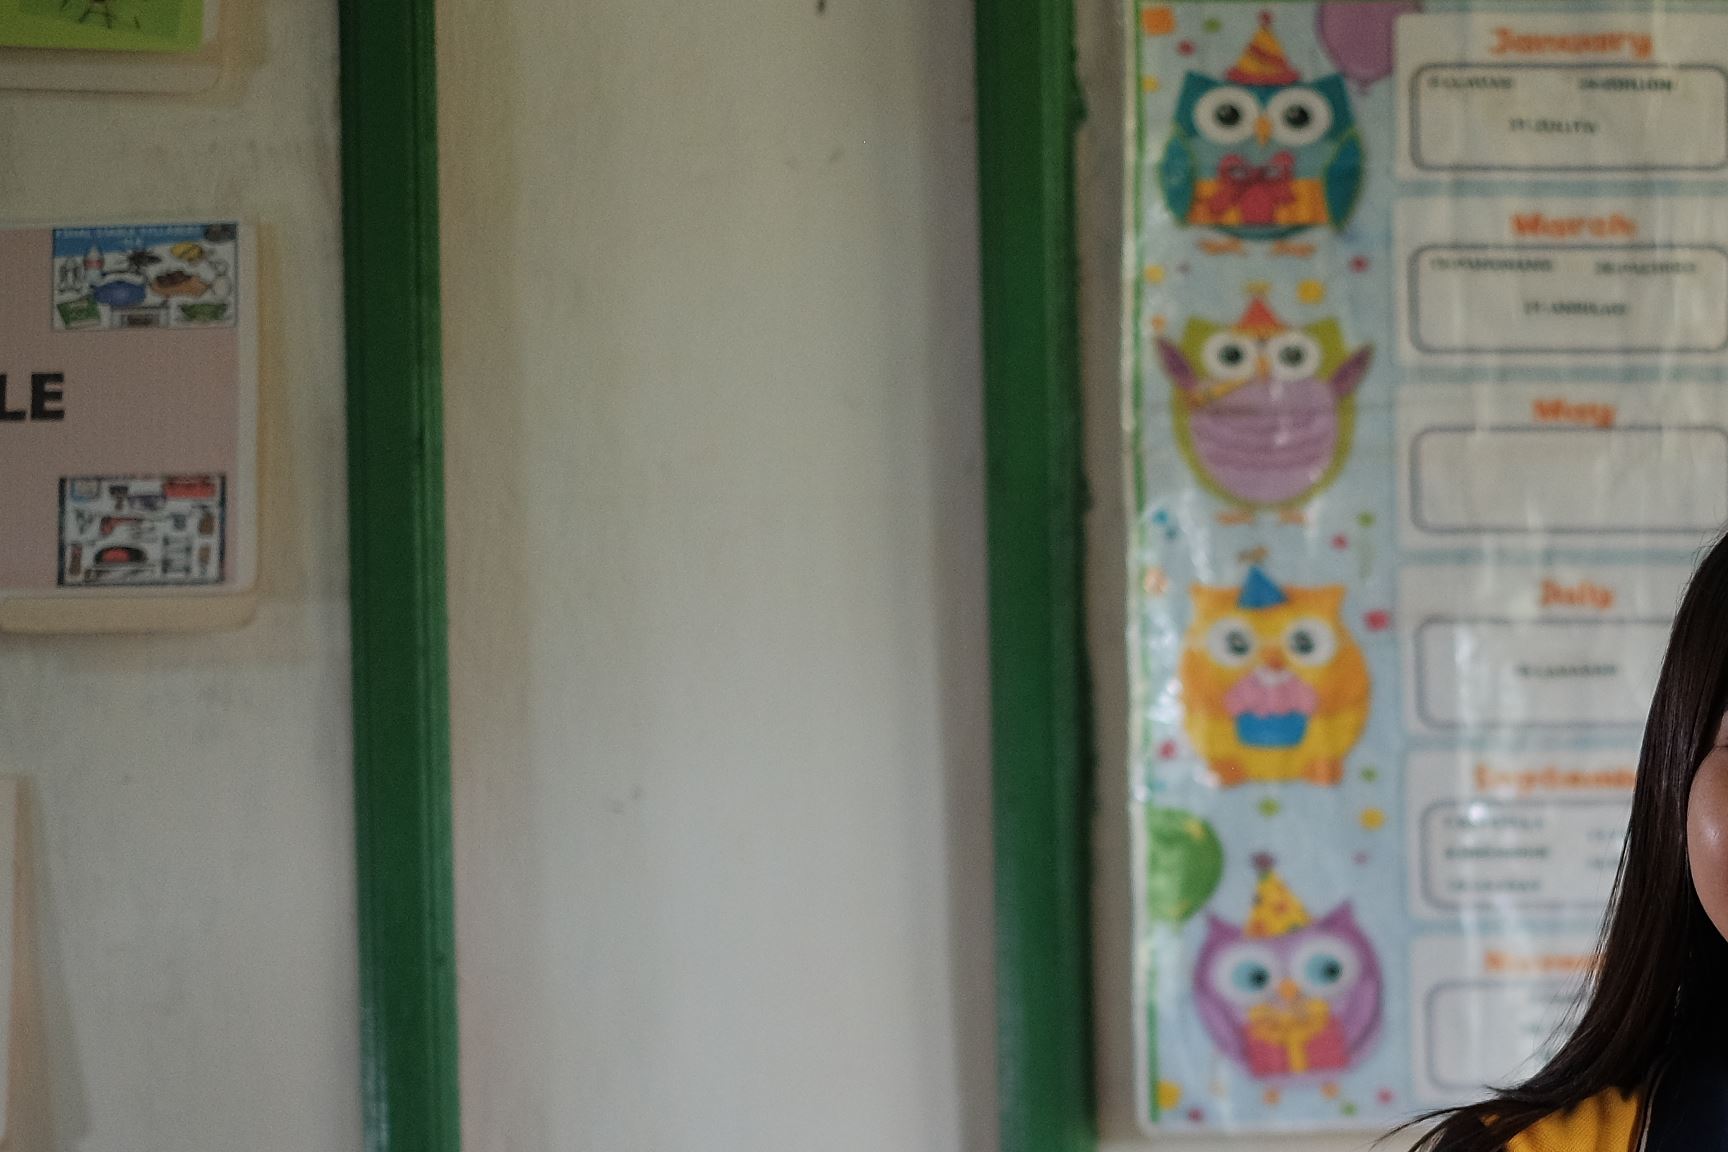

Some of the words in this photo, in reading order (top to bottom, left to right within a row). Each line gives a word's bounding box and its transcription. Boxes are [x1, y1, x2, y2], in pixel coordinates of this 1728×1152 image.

[1490, 26, 1656, 61] January
[1509, 211, 1638, 240] March
[1531, 398, 1617, 428] May
